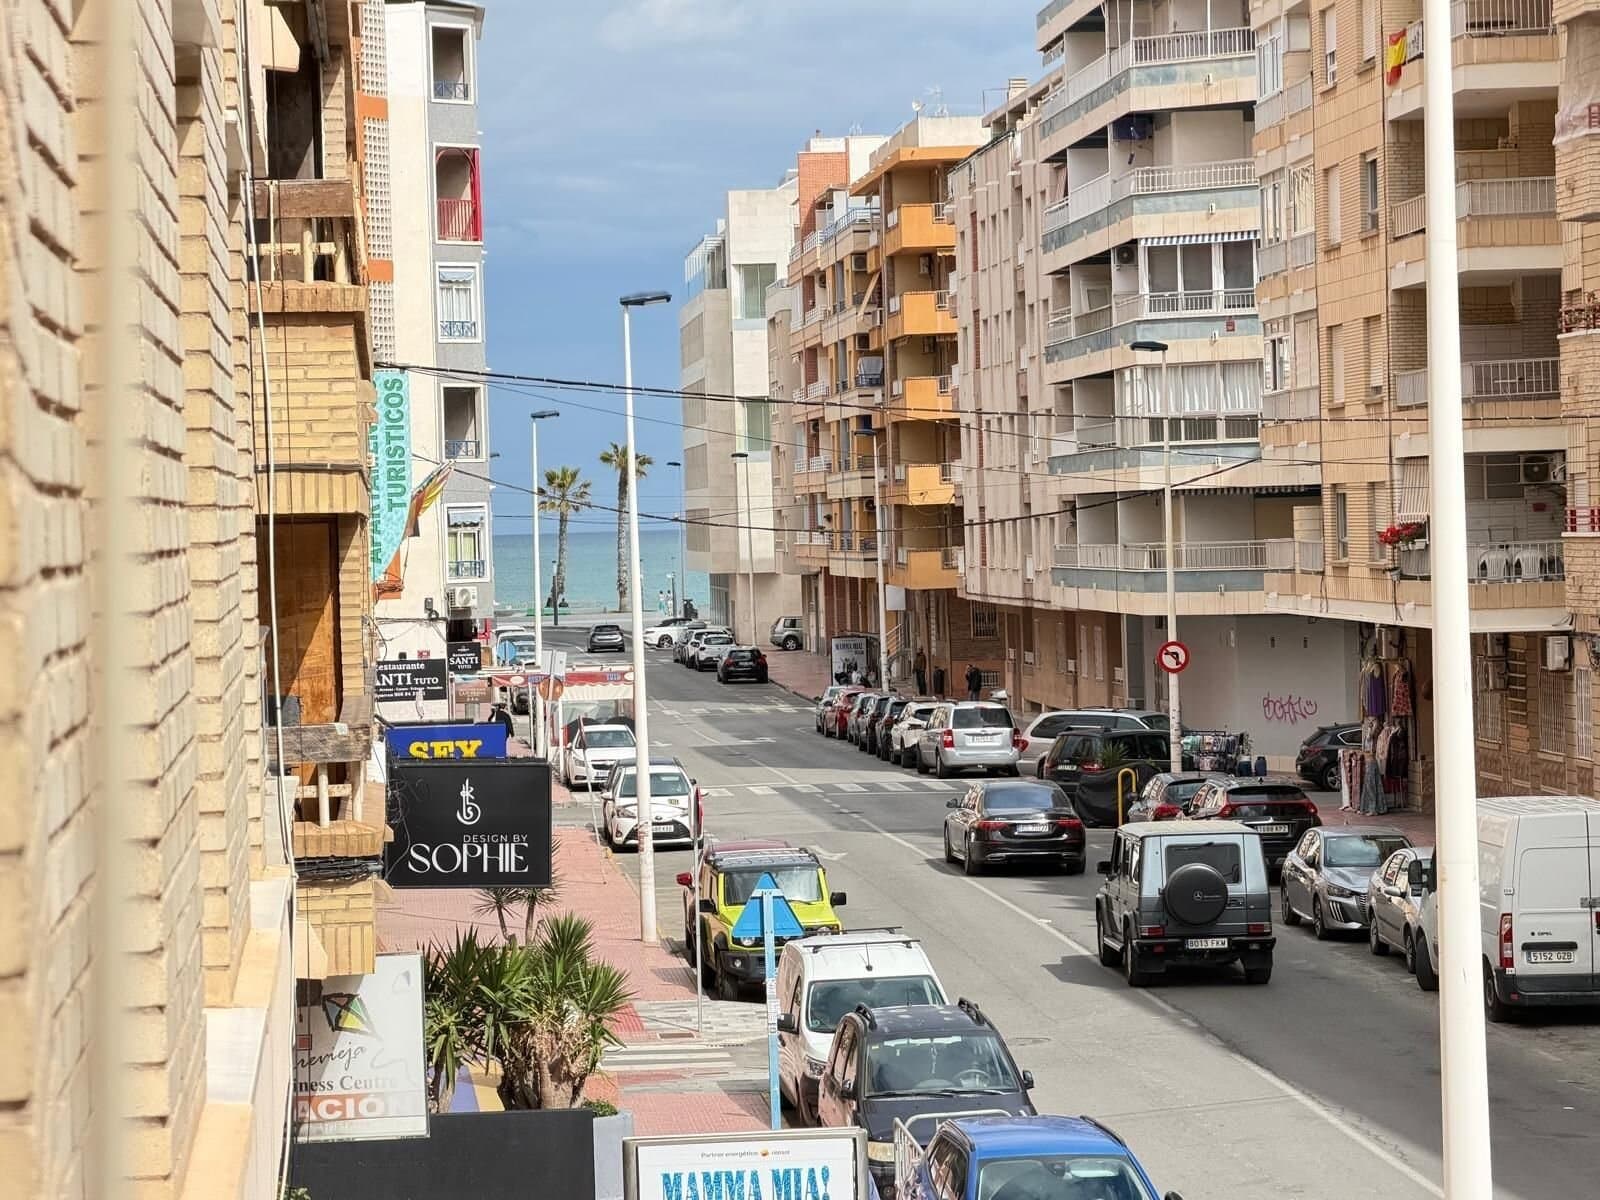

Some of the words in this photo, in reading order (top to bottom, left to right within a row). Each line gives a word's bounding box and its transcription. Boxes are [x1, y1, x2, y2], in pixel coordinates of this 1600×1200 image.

[383, 377, 407, 513] TURISTICOS
[449, 657, 479, 665] SANTI
[413, 676, 439, 685] TUTO
[463, 834, 508, 843] DESIGN
[513, 834, 528, 842] BY
[408, 843, 529, 874] SOPHIE
[1532, 952, 1553, 960] 5152
[1556, 951, 1572, 960] GZB
[293, 1079, 334, 1092] iness
[661, 1169, 763, 1200] MAMMA
[771, 1165, 831, 1200] MIA!
